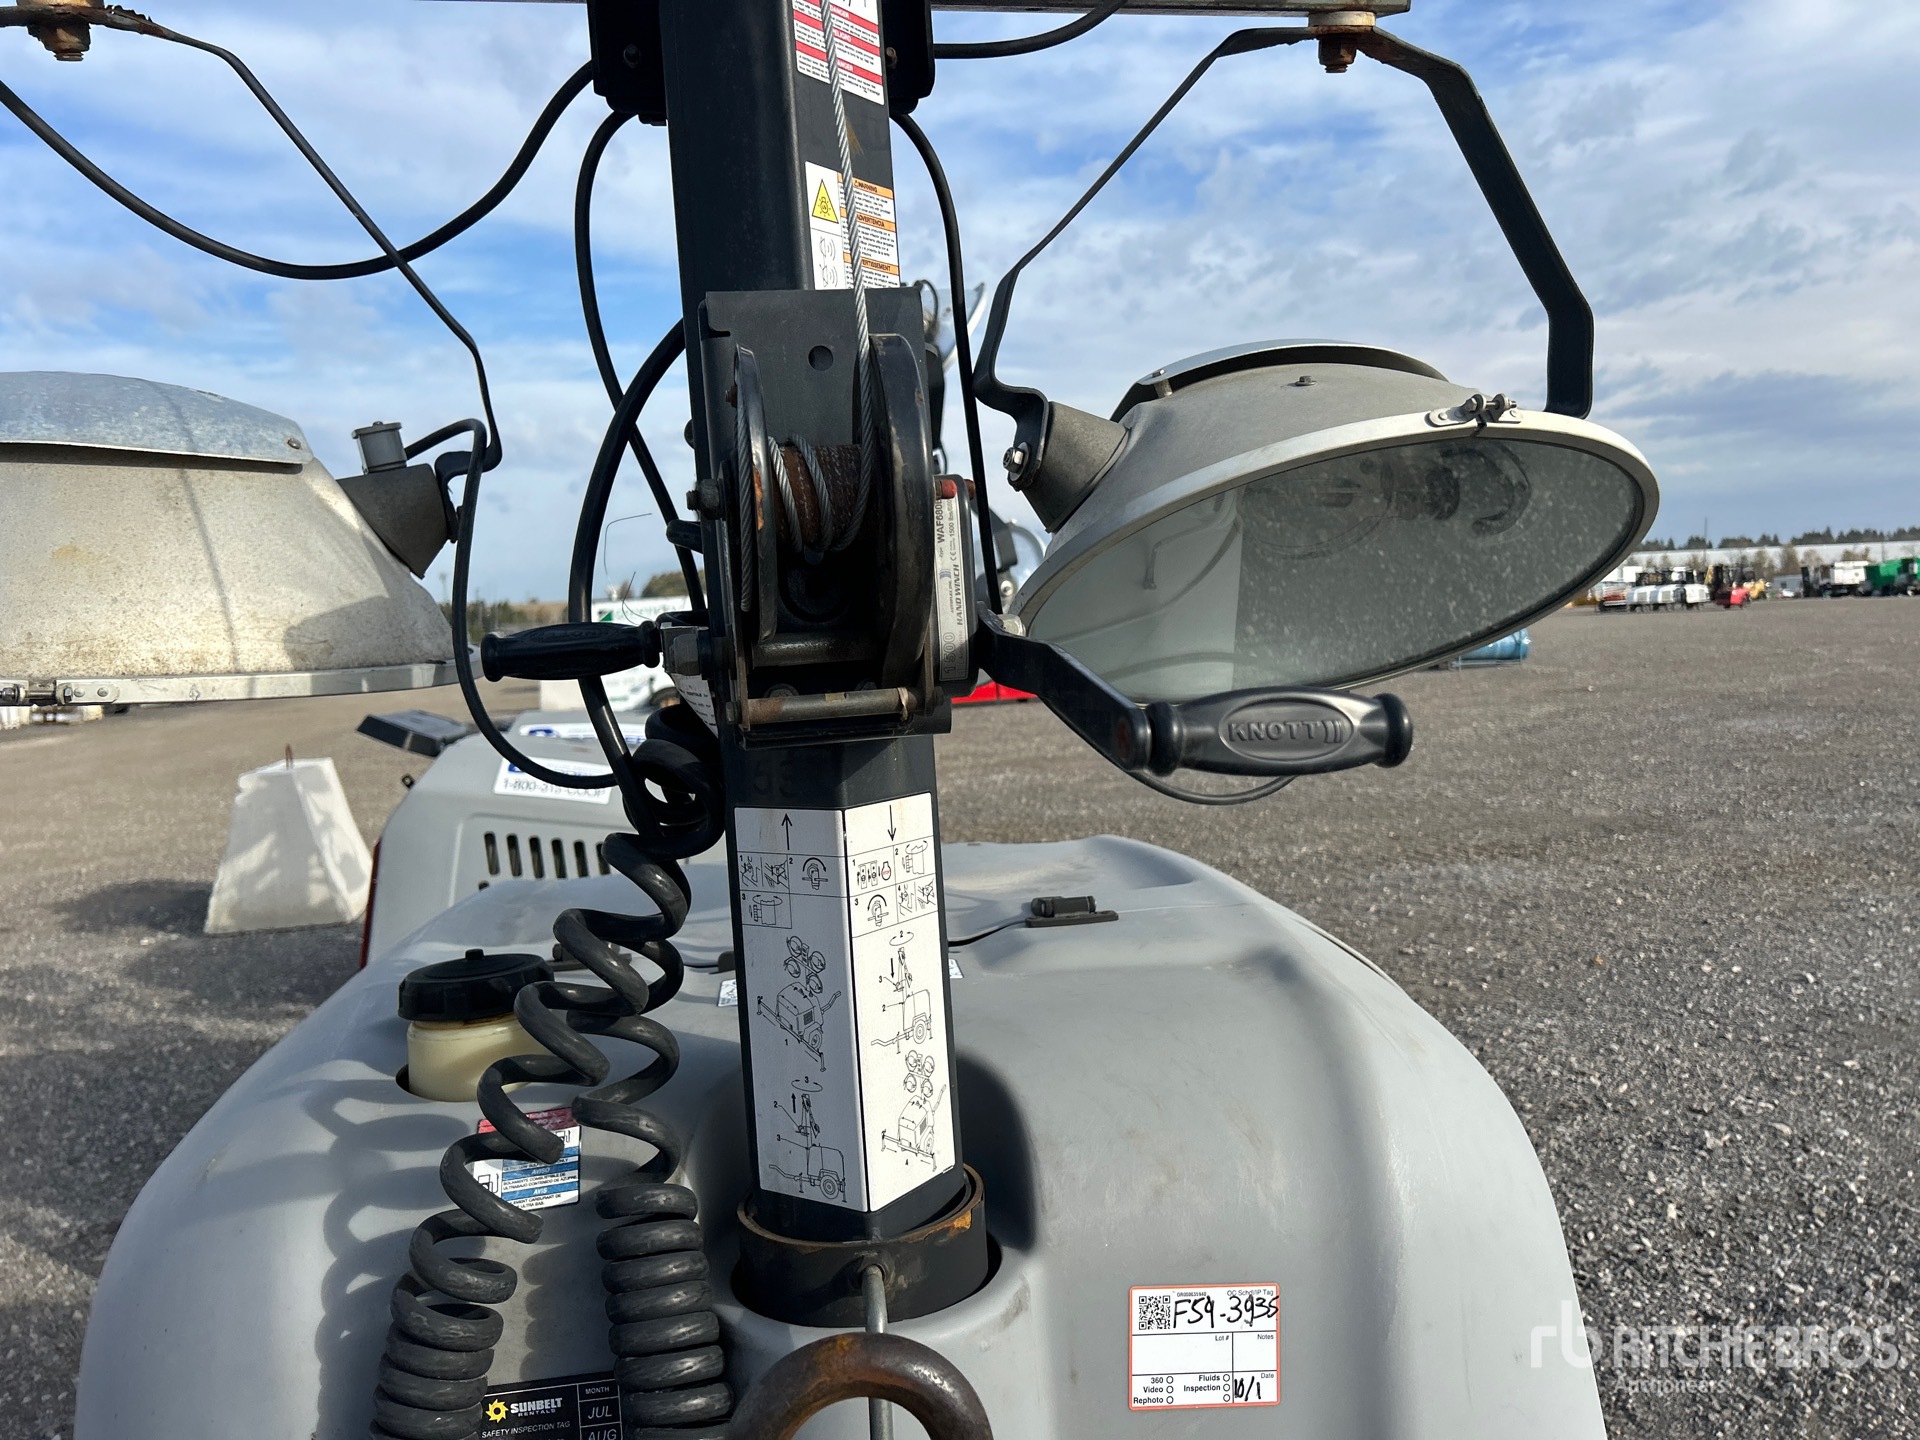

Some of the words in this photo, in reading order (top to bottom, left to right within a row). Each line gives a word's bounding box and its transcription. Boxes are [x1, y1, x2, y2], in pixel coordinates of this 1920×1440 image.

[953, 564, 961, 596] WINCH
[955, 598, 963, 626] HAND
[942, 632, 956, 673] 1500
[1227, 720, 1322, 742] KNOTT
[531, 1167, 550, 1175] AVISO
[533, 1187, 548, 1195] AVIS
[1263, 1289, 1274, 1297] Tag
[1198, 1374, 1221, 1382] Fluids
[585, 1386, 610, 1395] MONTH
[1143, 1386, 1164, 1394] Video
[1183, 1385, 1221, 1393] Inspection
[510, 1397, 563, 1414] SUNBELT
[1133, 1397, 1164, 1406] Rephoto
[517, 1408, 556, 1417] RENTALS
[588, 1405, 613, 1420] JUL
[481, 1428, 509, 1439] SAFETY
[510, 1423, 555, 1435] INSPECTION
[556, 1420, 571, 1429] TAG
[588, 1428, 617, 1440] AUG
